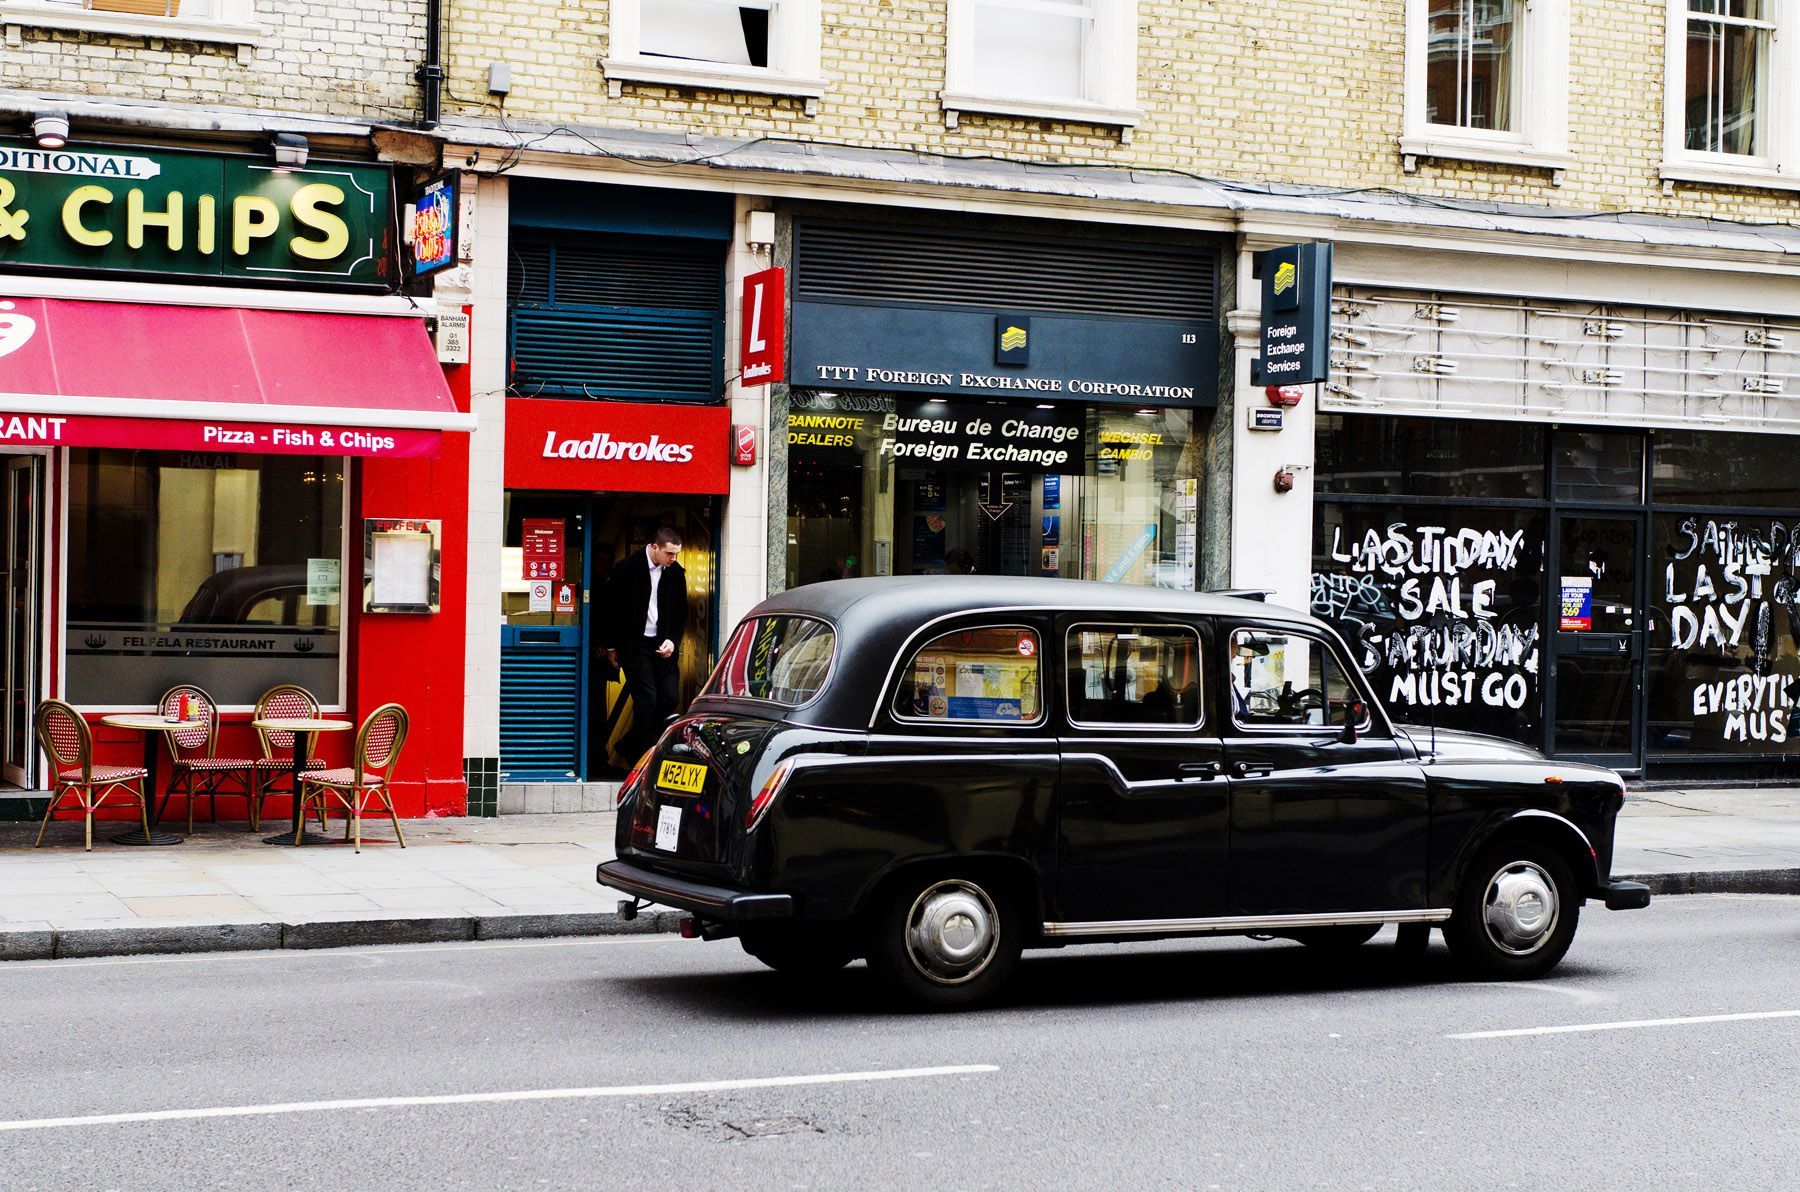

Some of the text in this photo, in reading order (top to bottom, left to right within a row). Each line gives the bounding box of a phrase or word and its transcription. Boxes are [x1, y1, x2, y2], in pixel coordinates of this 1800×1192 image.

[61, 183, 350, 260] CHIPS
[749, 283, 767, 354] L
[1181, 333, 1197, 344] 113
[1267, 324, 1297, 339] Foreign
[1267, 342, 1305, 356] Exchange
[1267, 359, 1301, 374] Services
[817, 365, 1195, 399] TTT FOREIGN EXCHANGE CORPORATION
[787, 414, 865, 431] BANKNOTE
[882, 413, 1080, 443] Bureau de Change
[203, 426, 255, 444] Pizza
[272, 429, 315, 446] Fish
[319, 431, 335, 447] &
[340, 432, 395, 452] Chips
[787, 432, 854, 447] DEALERS
[1099, 430, 1164, 446] WECHSEL
[541, 431, 695, 463] Ladbrokes
[879, 438, 1069, 467] Foreign Exchange
[1100, 447, 1153, 461] CAMBIO
[376, 521, 430, 532] FELFELA
[1666, 562, 1772, 604] LAST
[561, 594, 570, 602] 18
[1398, 575, 1498, 620] SALE
[1562, 607, 1580, 617] £69
[122, 636, 276, 650] FELFELA RESTAURANT
[1389, 670, 1528, 709] MUST GO
[1723, 709, 1791, 743] MUS
